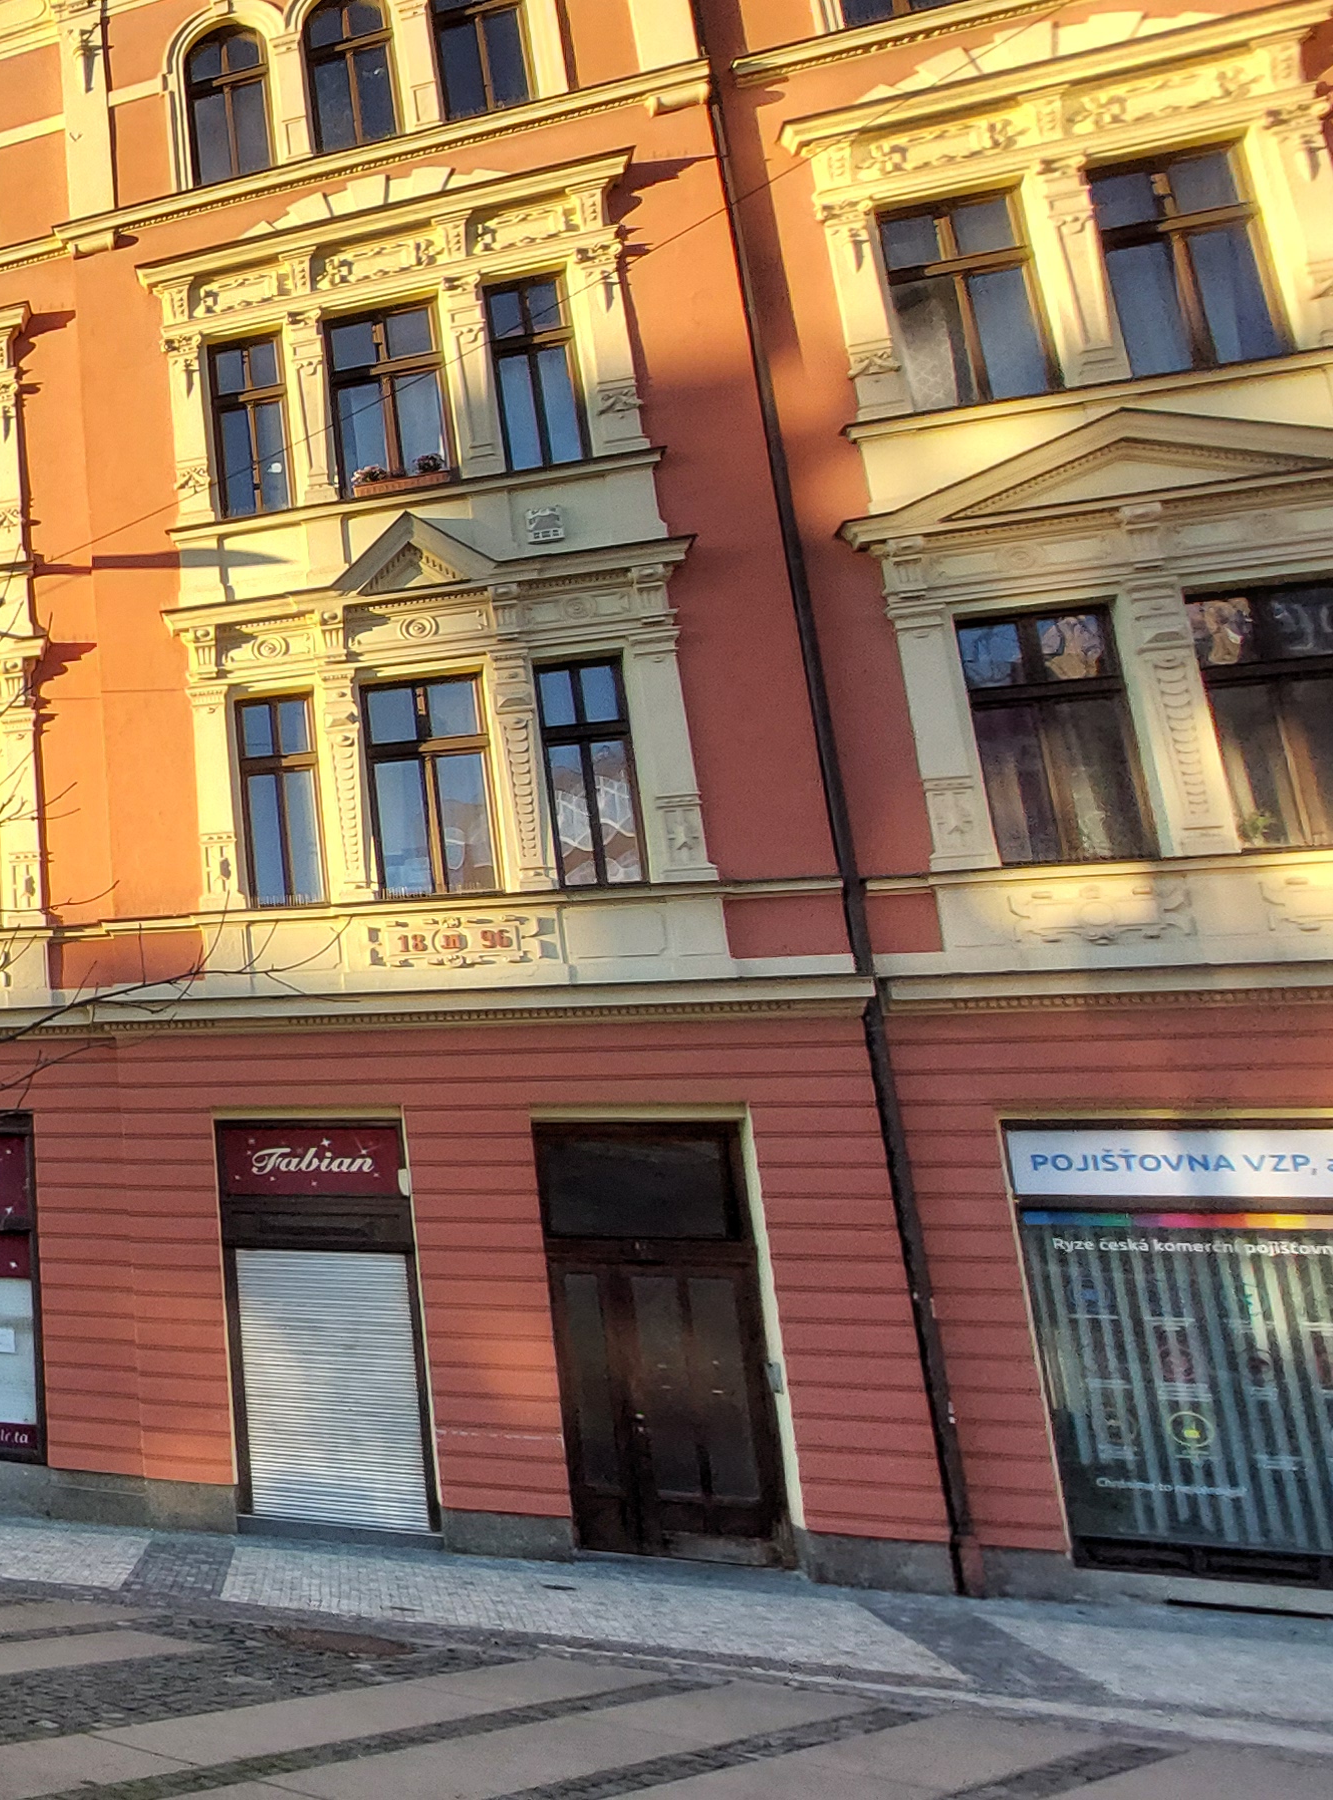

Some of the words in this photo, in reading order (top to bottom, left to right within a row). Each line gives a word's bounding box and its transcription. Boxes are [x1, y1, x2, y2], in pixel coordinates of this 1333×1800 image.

[398, 933, 428, 953] 18
[479, 928, 514, 949] 96
[251, 1147, 375, 1176] Fabian
[1030, 1148, 1236, 1173] POJIŠŤOVNA
[1241, 1153, 1318, 1176] VZP,
[1052, 1237, 1094, 1252] Ryze
[1099, 1236, 1149, 1252] česká
